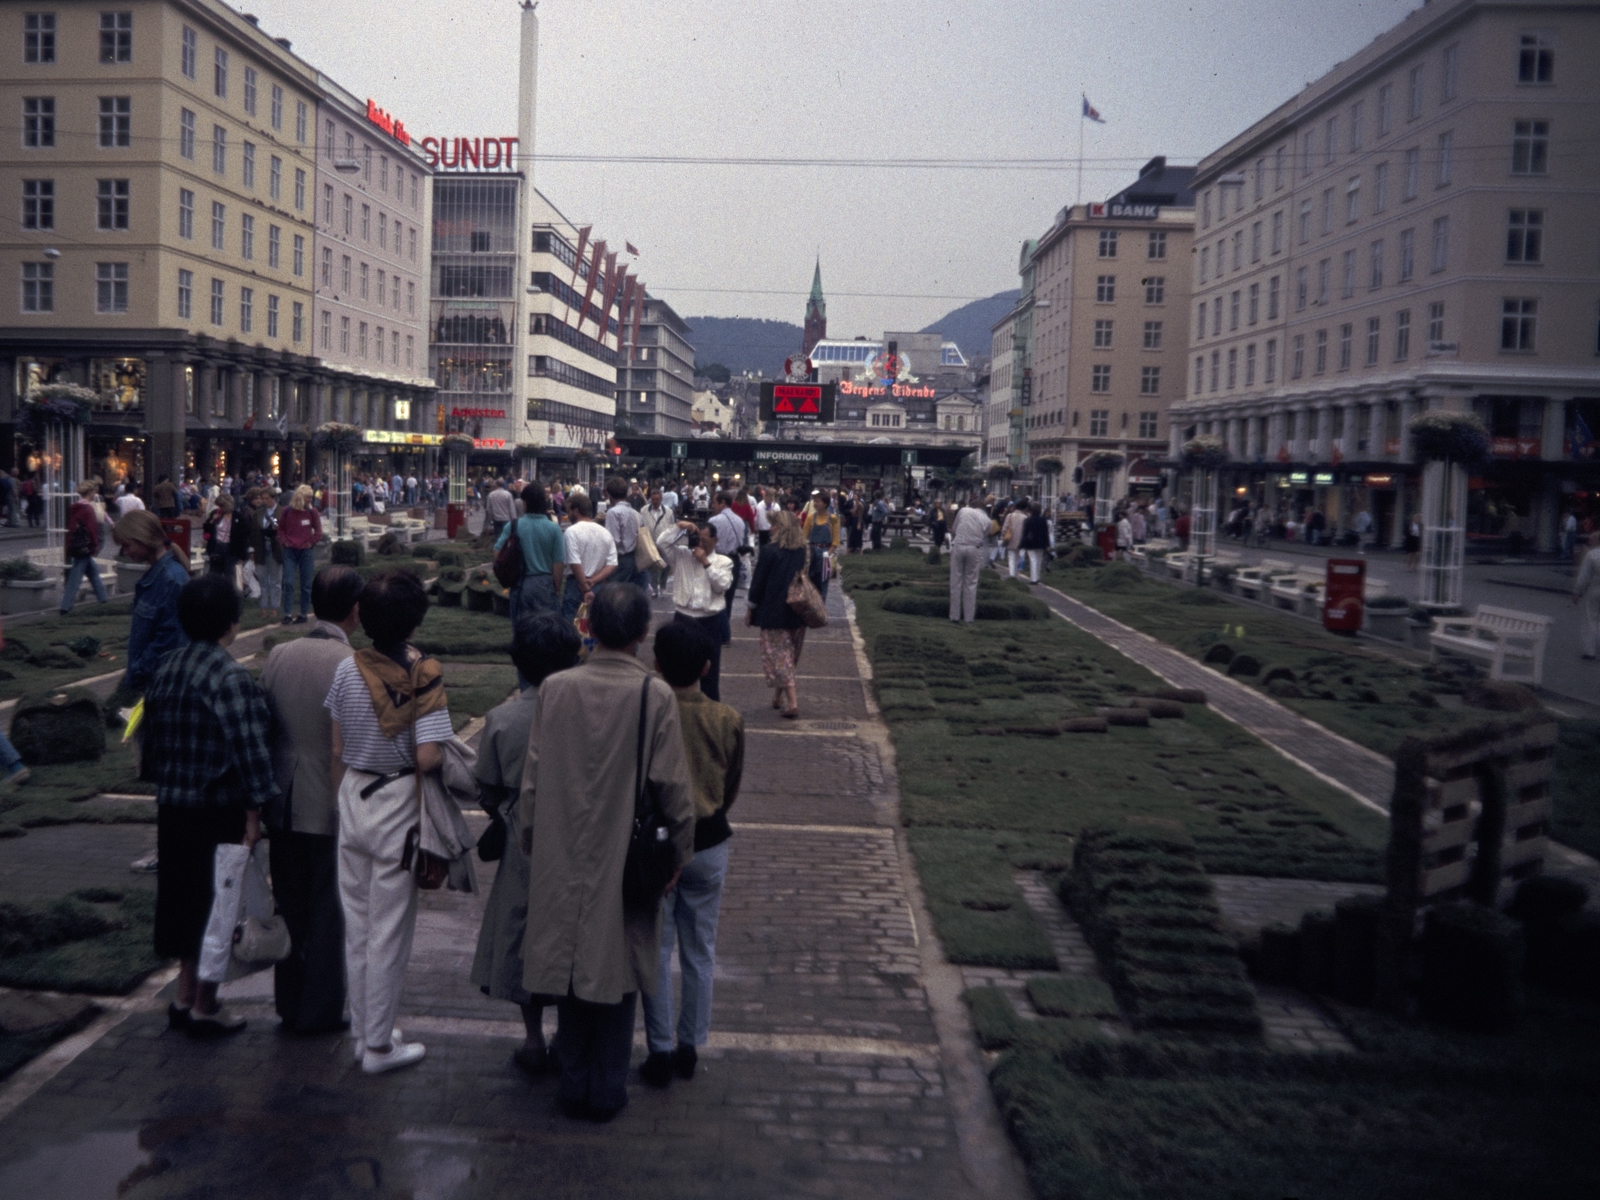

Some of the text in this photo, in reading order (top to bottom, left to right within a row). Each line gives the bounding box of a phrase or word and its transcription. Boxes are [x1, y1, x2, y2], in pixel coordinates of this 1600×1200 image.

[421, 137, 519, 168] SUNDT
[1112, 205, 1157, 217] BANK
[839, 380, 935, 398] Bergens Tidende
[451, 406, 506, 418] Adelsten
[473, 437, 506, 449] CITY
[756, 452, 819, 462] INFORMATION
